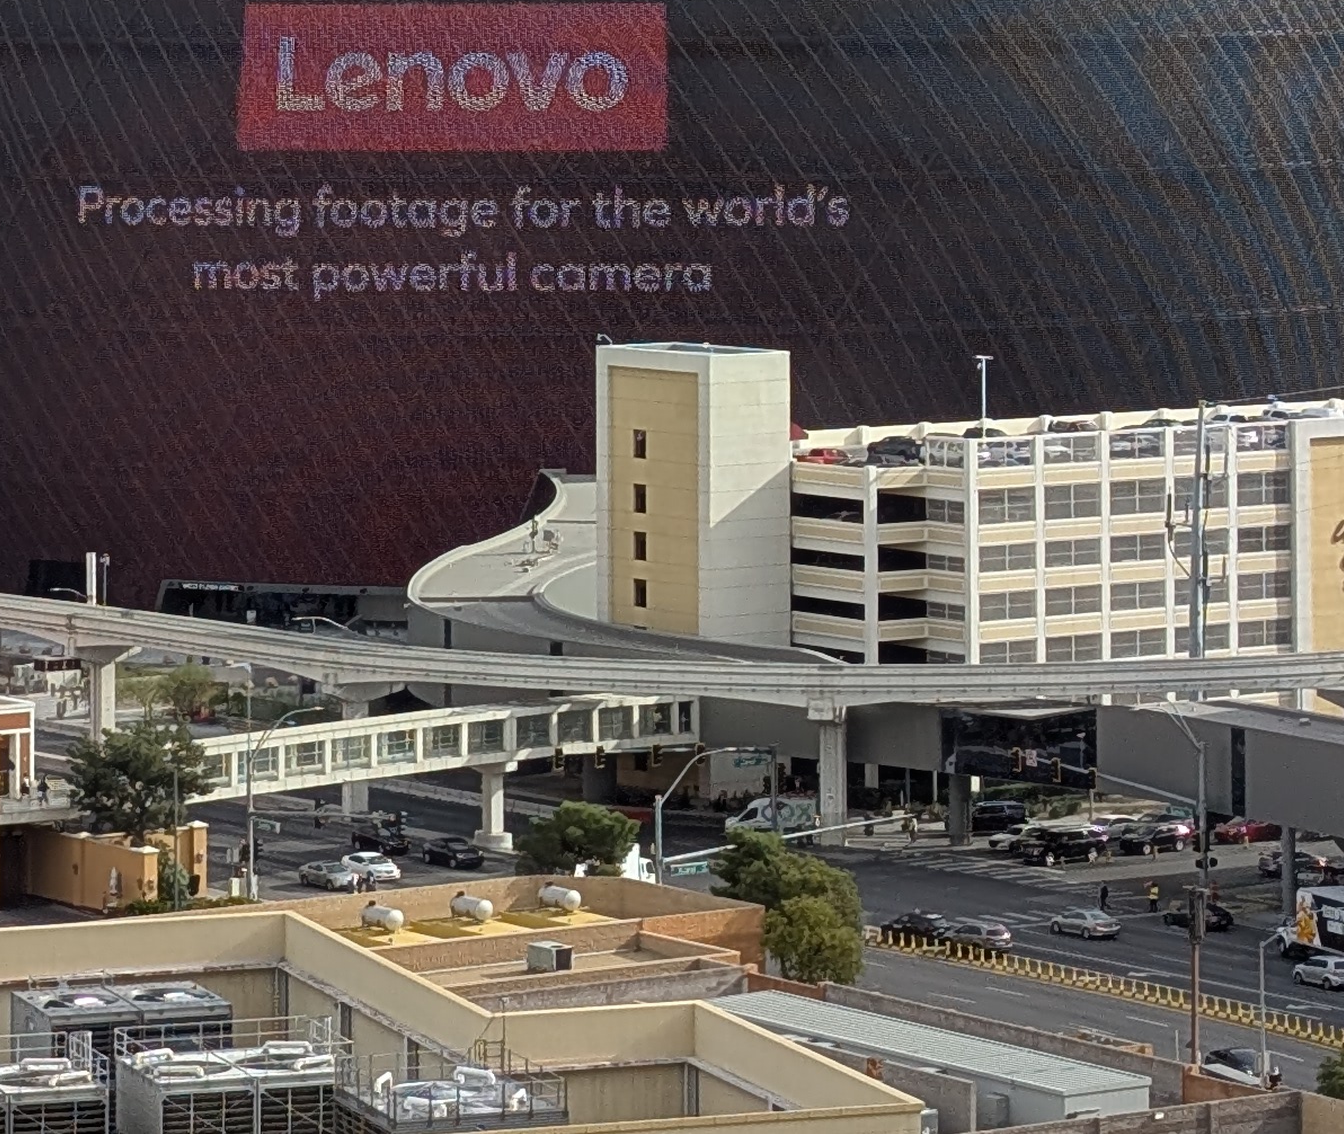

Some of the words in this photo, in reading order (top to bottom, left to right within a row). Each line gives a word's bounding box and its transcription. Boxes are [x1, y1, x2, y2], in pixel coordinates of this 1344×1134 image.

[275, 35, 631, 113] Lenovo
[77, 184, 302, 238] Processing
[312, 183, 500, 239] footage
[511, 183, 582, 229] for
[592, 183, 673, 230] the
[681, 183, 851, 228] world's
[192, 257, 300, 292] most
[311, 250, 520, 303] powerful
[529, 261, 714, 293] camera
